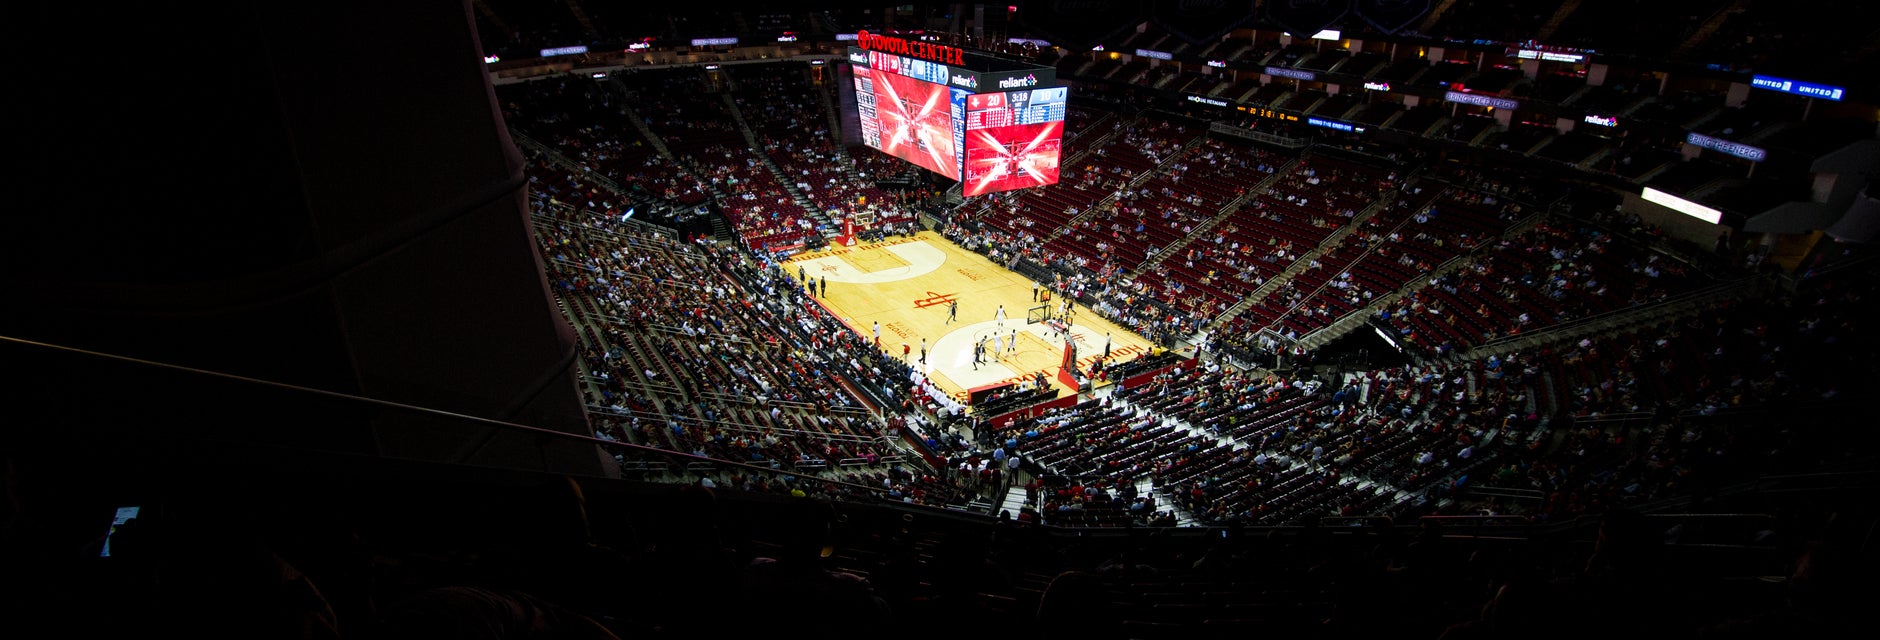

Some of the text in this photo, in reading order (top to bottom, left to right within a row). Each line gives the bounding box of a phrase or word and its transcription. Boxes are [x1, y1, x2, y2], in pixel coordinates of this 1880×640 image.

[871, 34, 908, 55] TOYOTA
[910, 41, 963, 66] CENTER
[952, 74, 970, 87] reliant
[1000, 77, 1028, 88] reliant
[1364, 81, 1384, 91] reliant
[1753, 79, 1782, 88] UNITED
[1041, 90, 1051, 101] 10
[1799, 86, 1831, 96] UNITED
[988, 95, 1000, 106] 20
[1012, 92, 1028, 102] 3:18
[1585, 115, 1609, 126] reliant
[1689, 134, 1763, 158] BRING THE ENERGY
